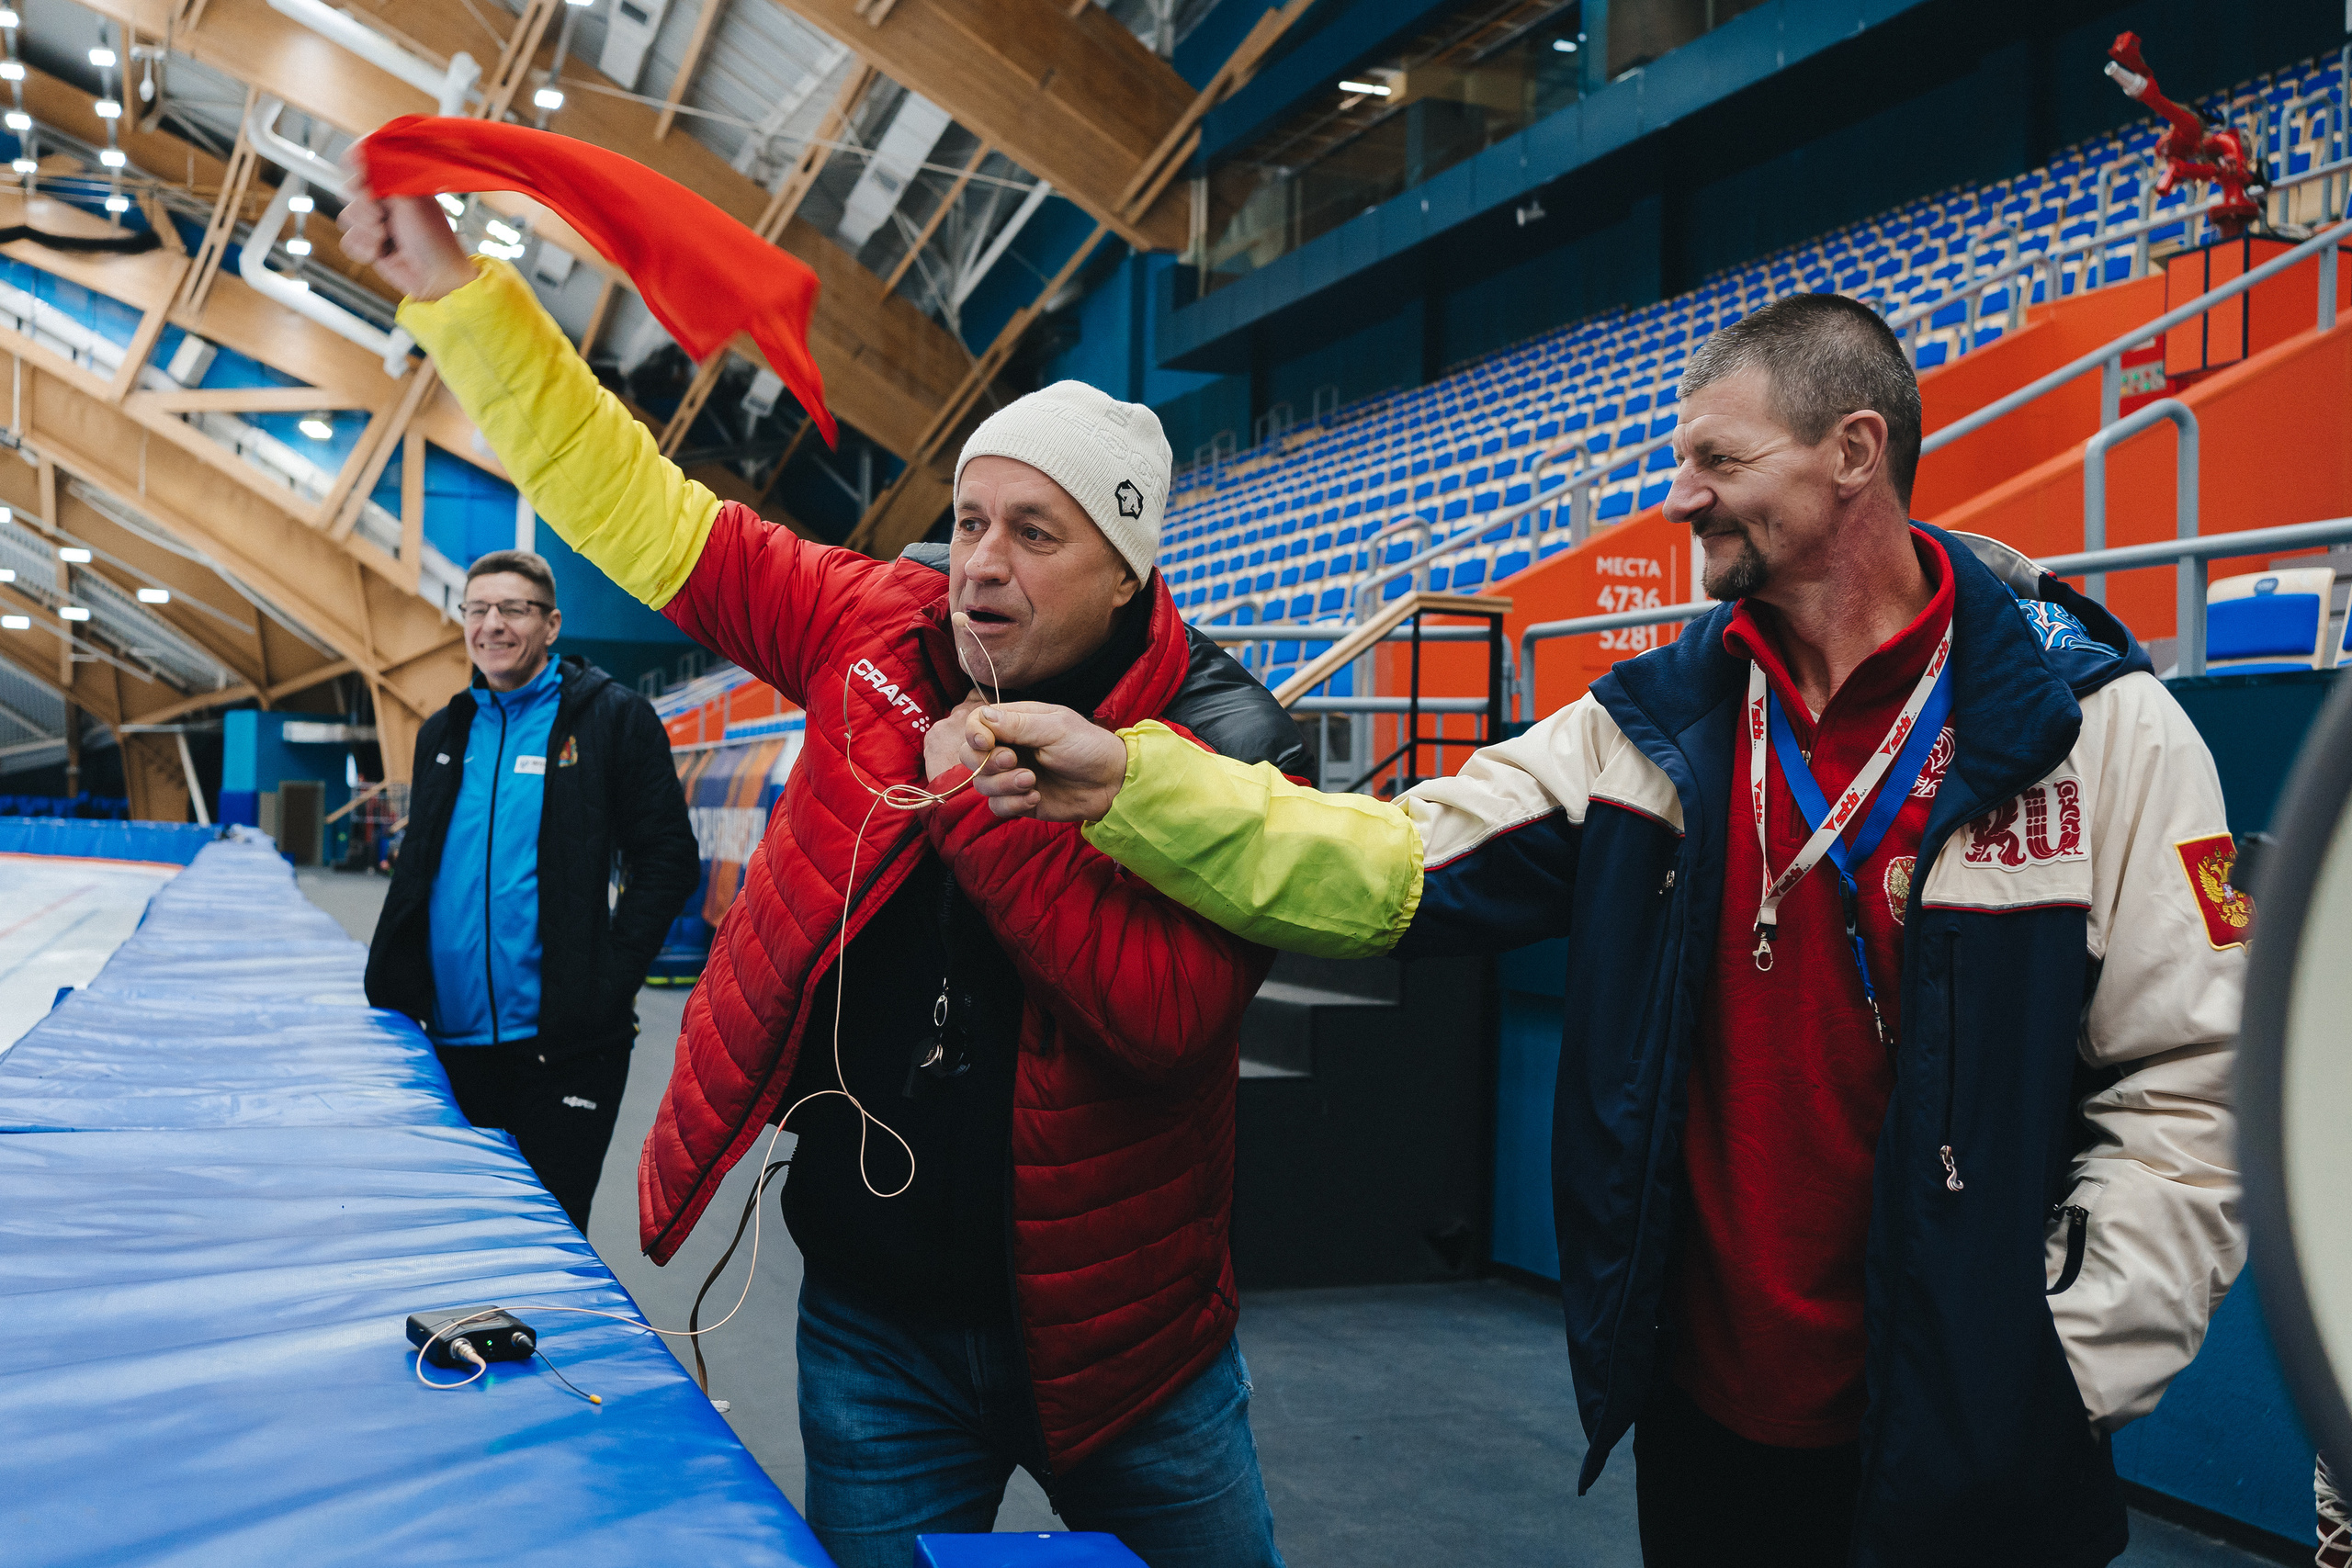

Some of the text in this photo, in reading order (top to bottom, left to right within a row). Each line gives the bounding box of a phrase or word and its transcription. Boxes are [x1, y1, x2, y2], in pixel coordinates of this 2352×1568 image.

[1596, 556, 1662, 578] МЕСТА
[1597, 585, 1662, 613] 4736
[853, 658, 922, 716] CRAFT
